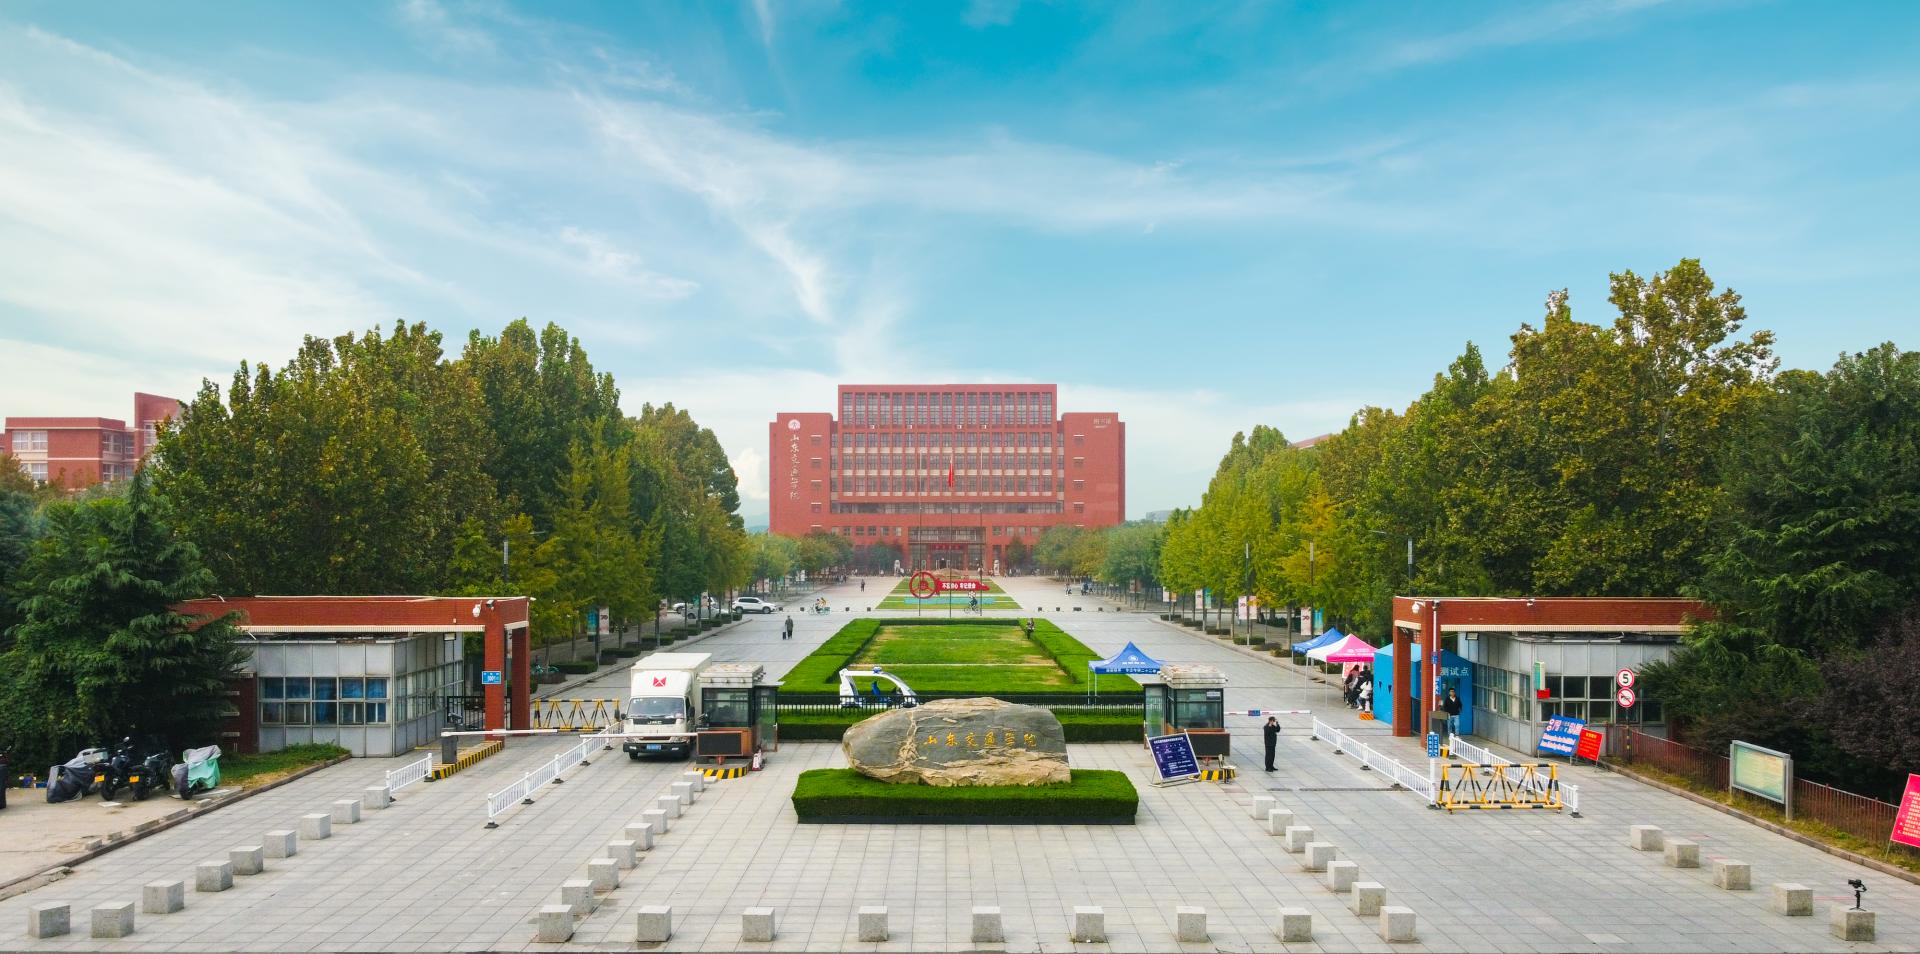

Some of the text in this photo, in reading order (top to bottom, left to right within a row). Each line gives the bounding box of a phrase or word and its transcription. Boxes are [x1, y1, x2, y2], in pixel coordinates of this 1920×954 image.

[790, 434, 801, 501] 山东交通学院
[1622, 673, 1629, 684] 5
[924, 731, 1037, 748] 山东交通学院
